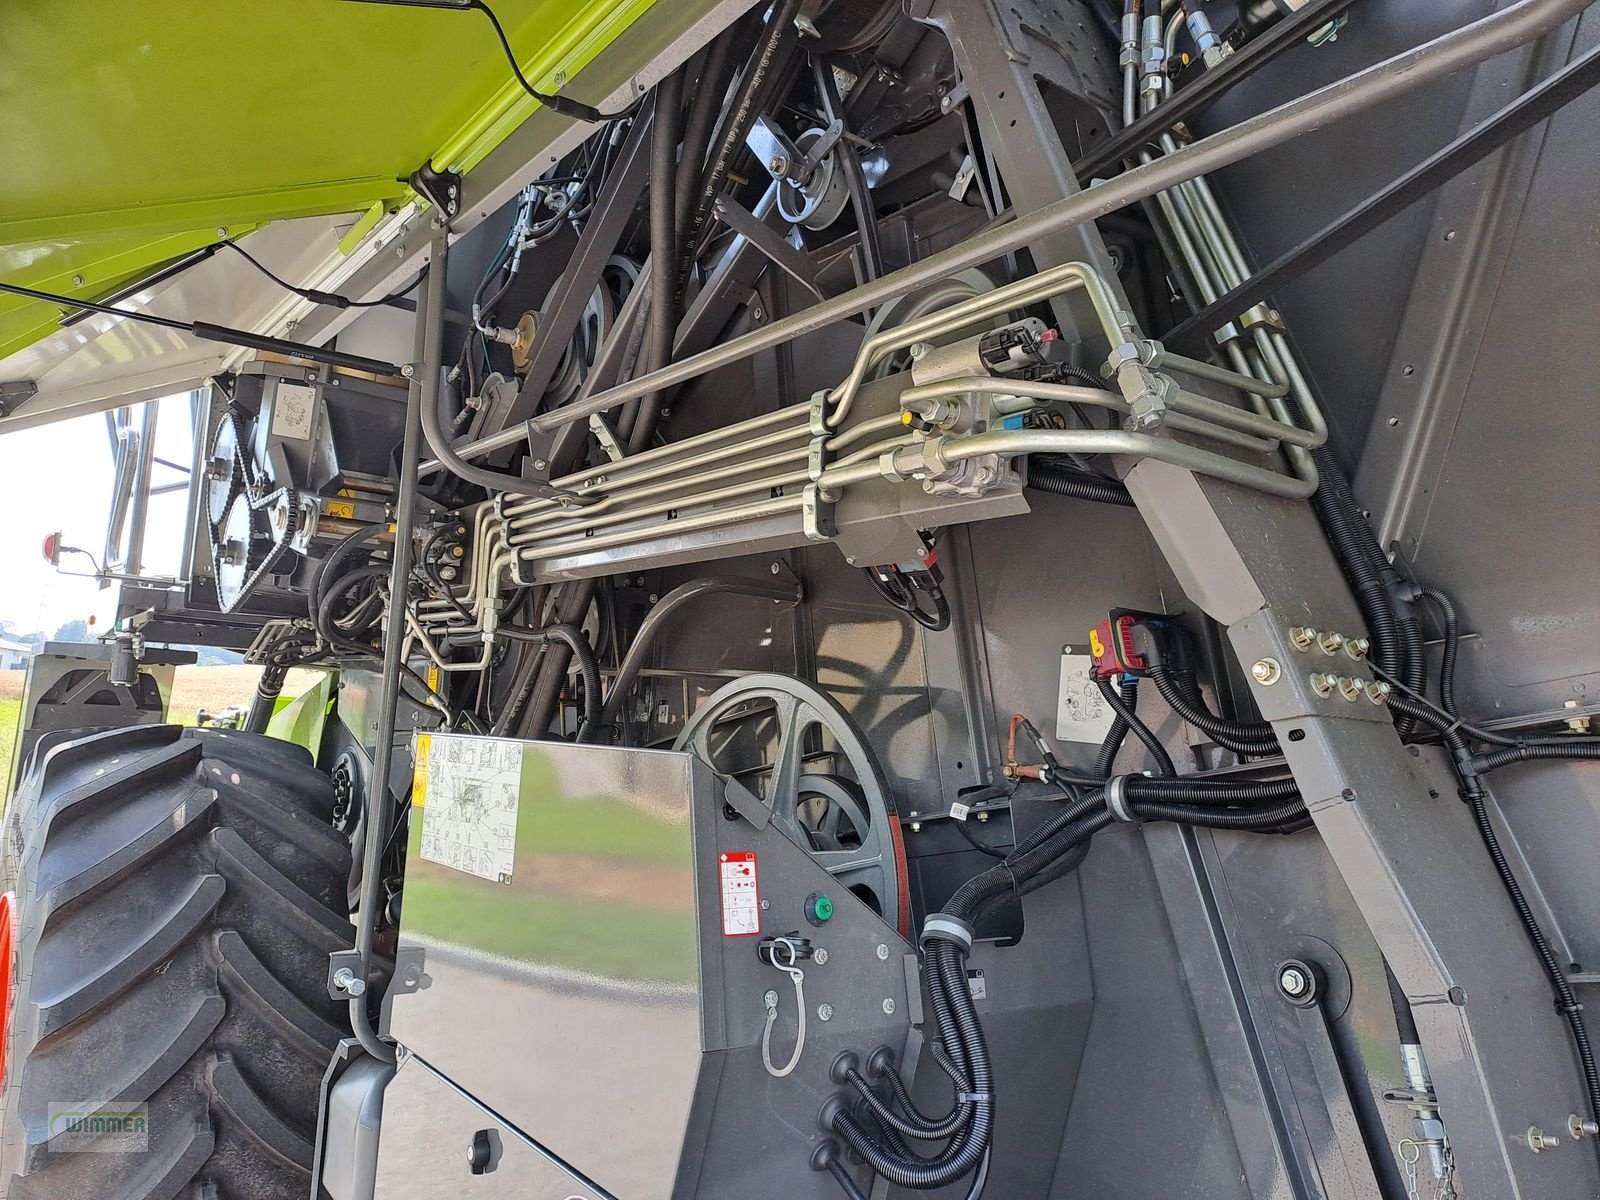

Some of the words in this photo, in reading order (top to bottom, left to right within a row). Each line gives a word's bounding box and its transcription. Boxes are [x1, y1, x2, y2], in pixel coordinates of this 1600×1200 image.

[761, 59, 769, 67] to
[737, 109, 747, 122] 250
[727, 127, 739, 142] MPa
[723, 144, 732, 154] 1.7
[715, 159, 725, 170] bar
[711, 172, 720, 180] 17
[705, 185, 714, 197] WP
